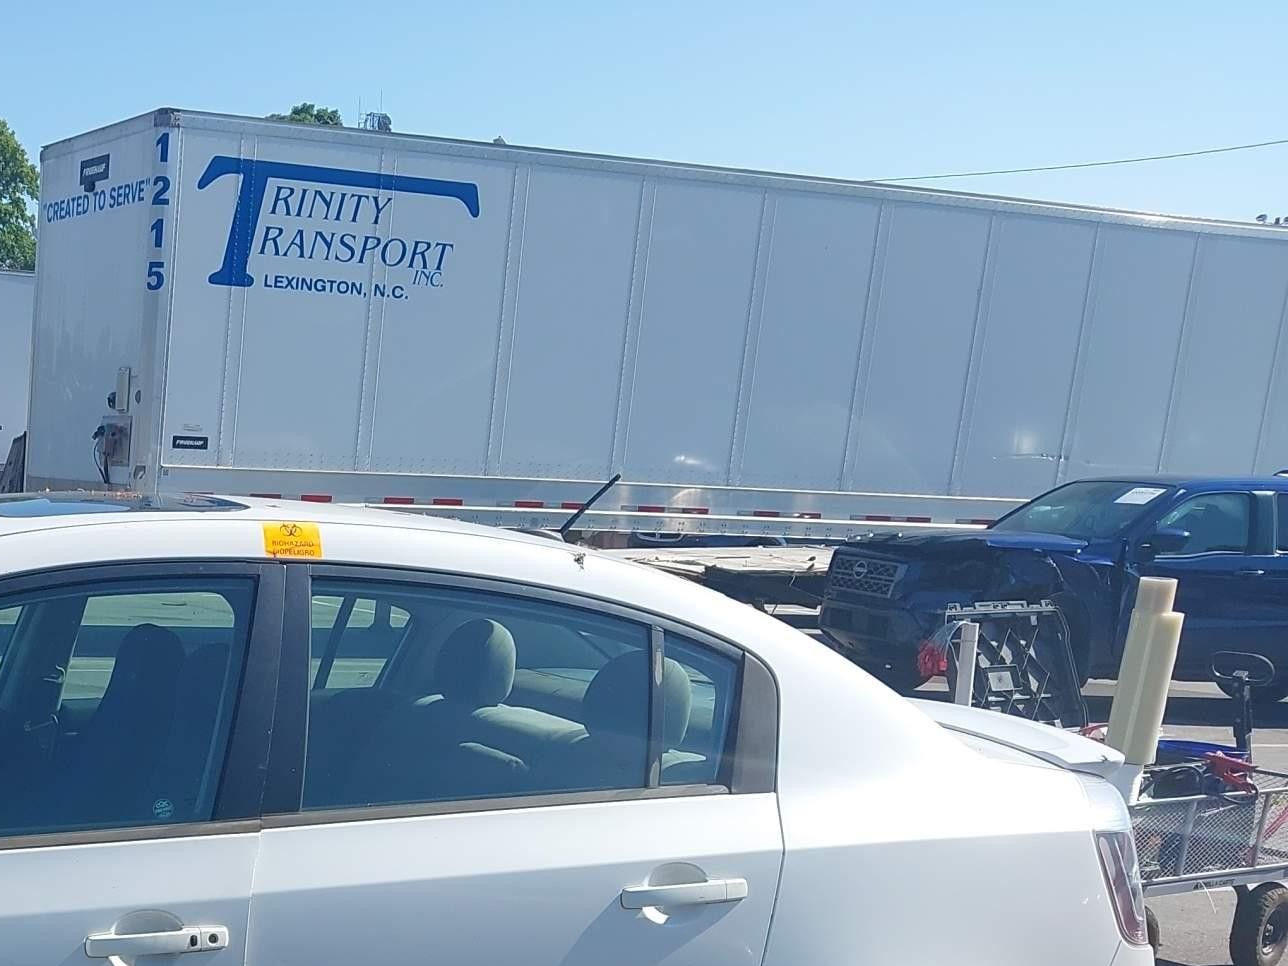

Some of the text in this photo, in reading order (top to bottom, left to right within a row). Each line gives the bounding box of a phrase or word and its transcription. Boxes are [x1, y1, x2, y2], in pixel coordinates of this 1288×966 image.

[93, 189, 106, 213] TO
[109, 178, 151, 209] SERVE"
[263, 274, 409, 300] LEXINGTON, N.C.
[412, 269, 444, 288] INC.
